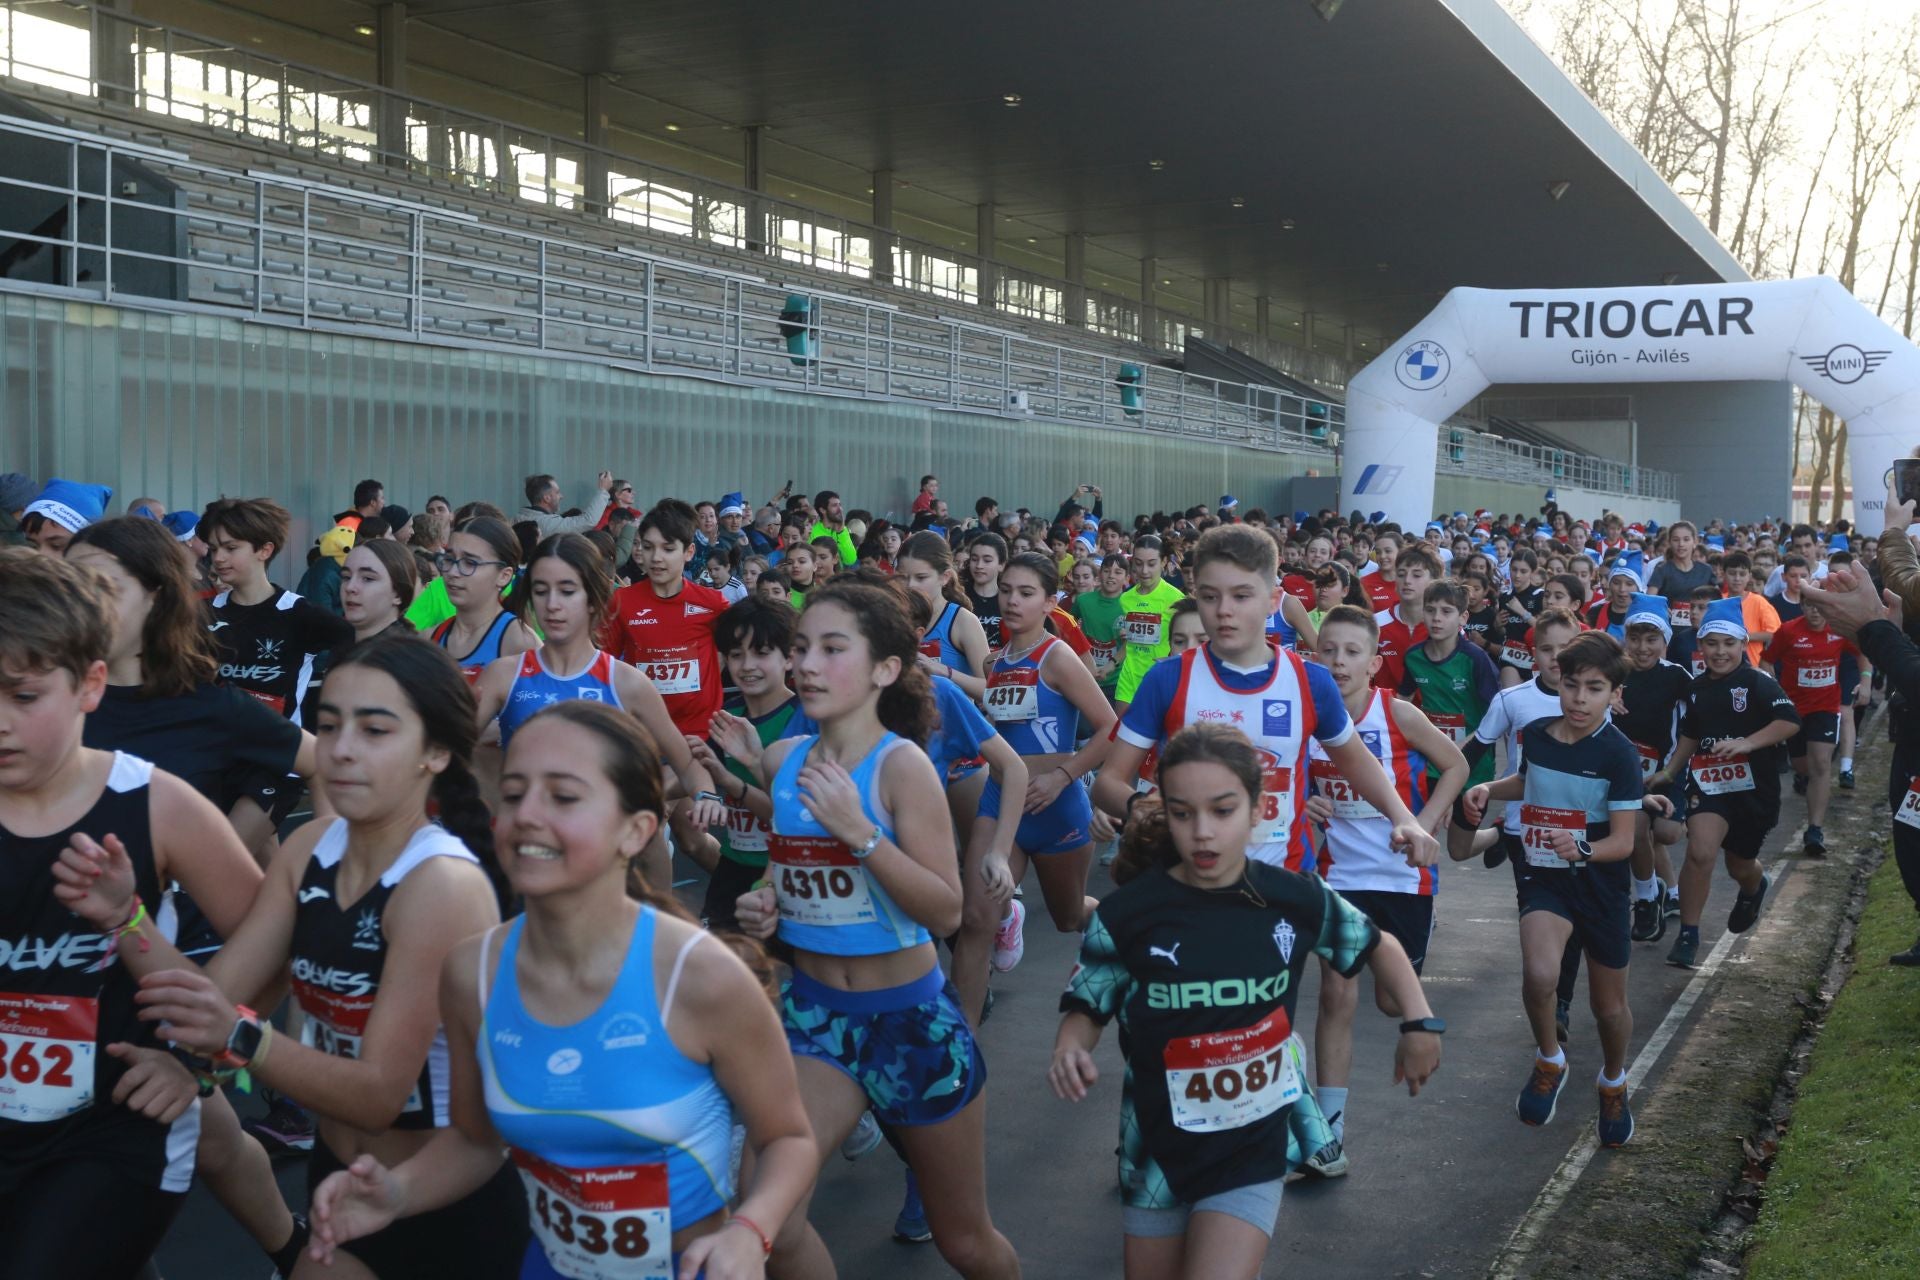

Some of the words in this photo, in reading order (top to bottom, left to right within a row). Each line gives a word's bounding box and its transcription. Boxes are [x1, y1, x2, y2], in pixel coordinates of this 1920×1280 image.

[1509, 297, 1755, 338] TRIOCAR
[1405, 343, 1443, 357] BMW
[1571, 349, 1617, 367] Gijón
[1636, 348, 1690, 364] Avilés
[1830, 358, 1862, 371] MINI
[1129, 623, 1155, 635] 4315
[645, 662, 691, 680] 4377
[1804, 668, 1833, 680] 4231
[988, 687, 1027, 706] 4317
[1700, 765, 1747, 784] 4208
[782, 868, 854, 900] 4310
[1147, 968, 1290, 1009] SIROKO
[1207, 1033, 1245, 1046] Carrera
[0, 1039, 74, 1089] 62
[1184, 1047, 1285, 1104] 4087
[585, 1169, 638, 1184] Popular
[535, 1186, 650, 1260] 4338
